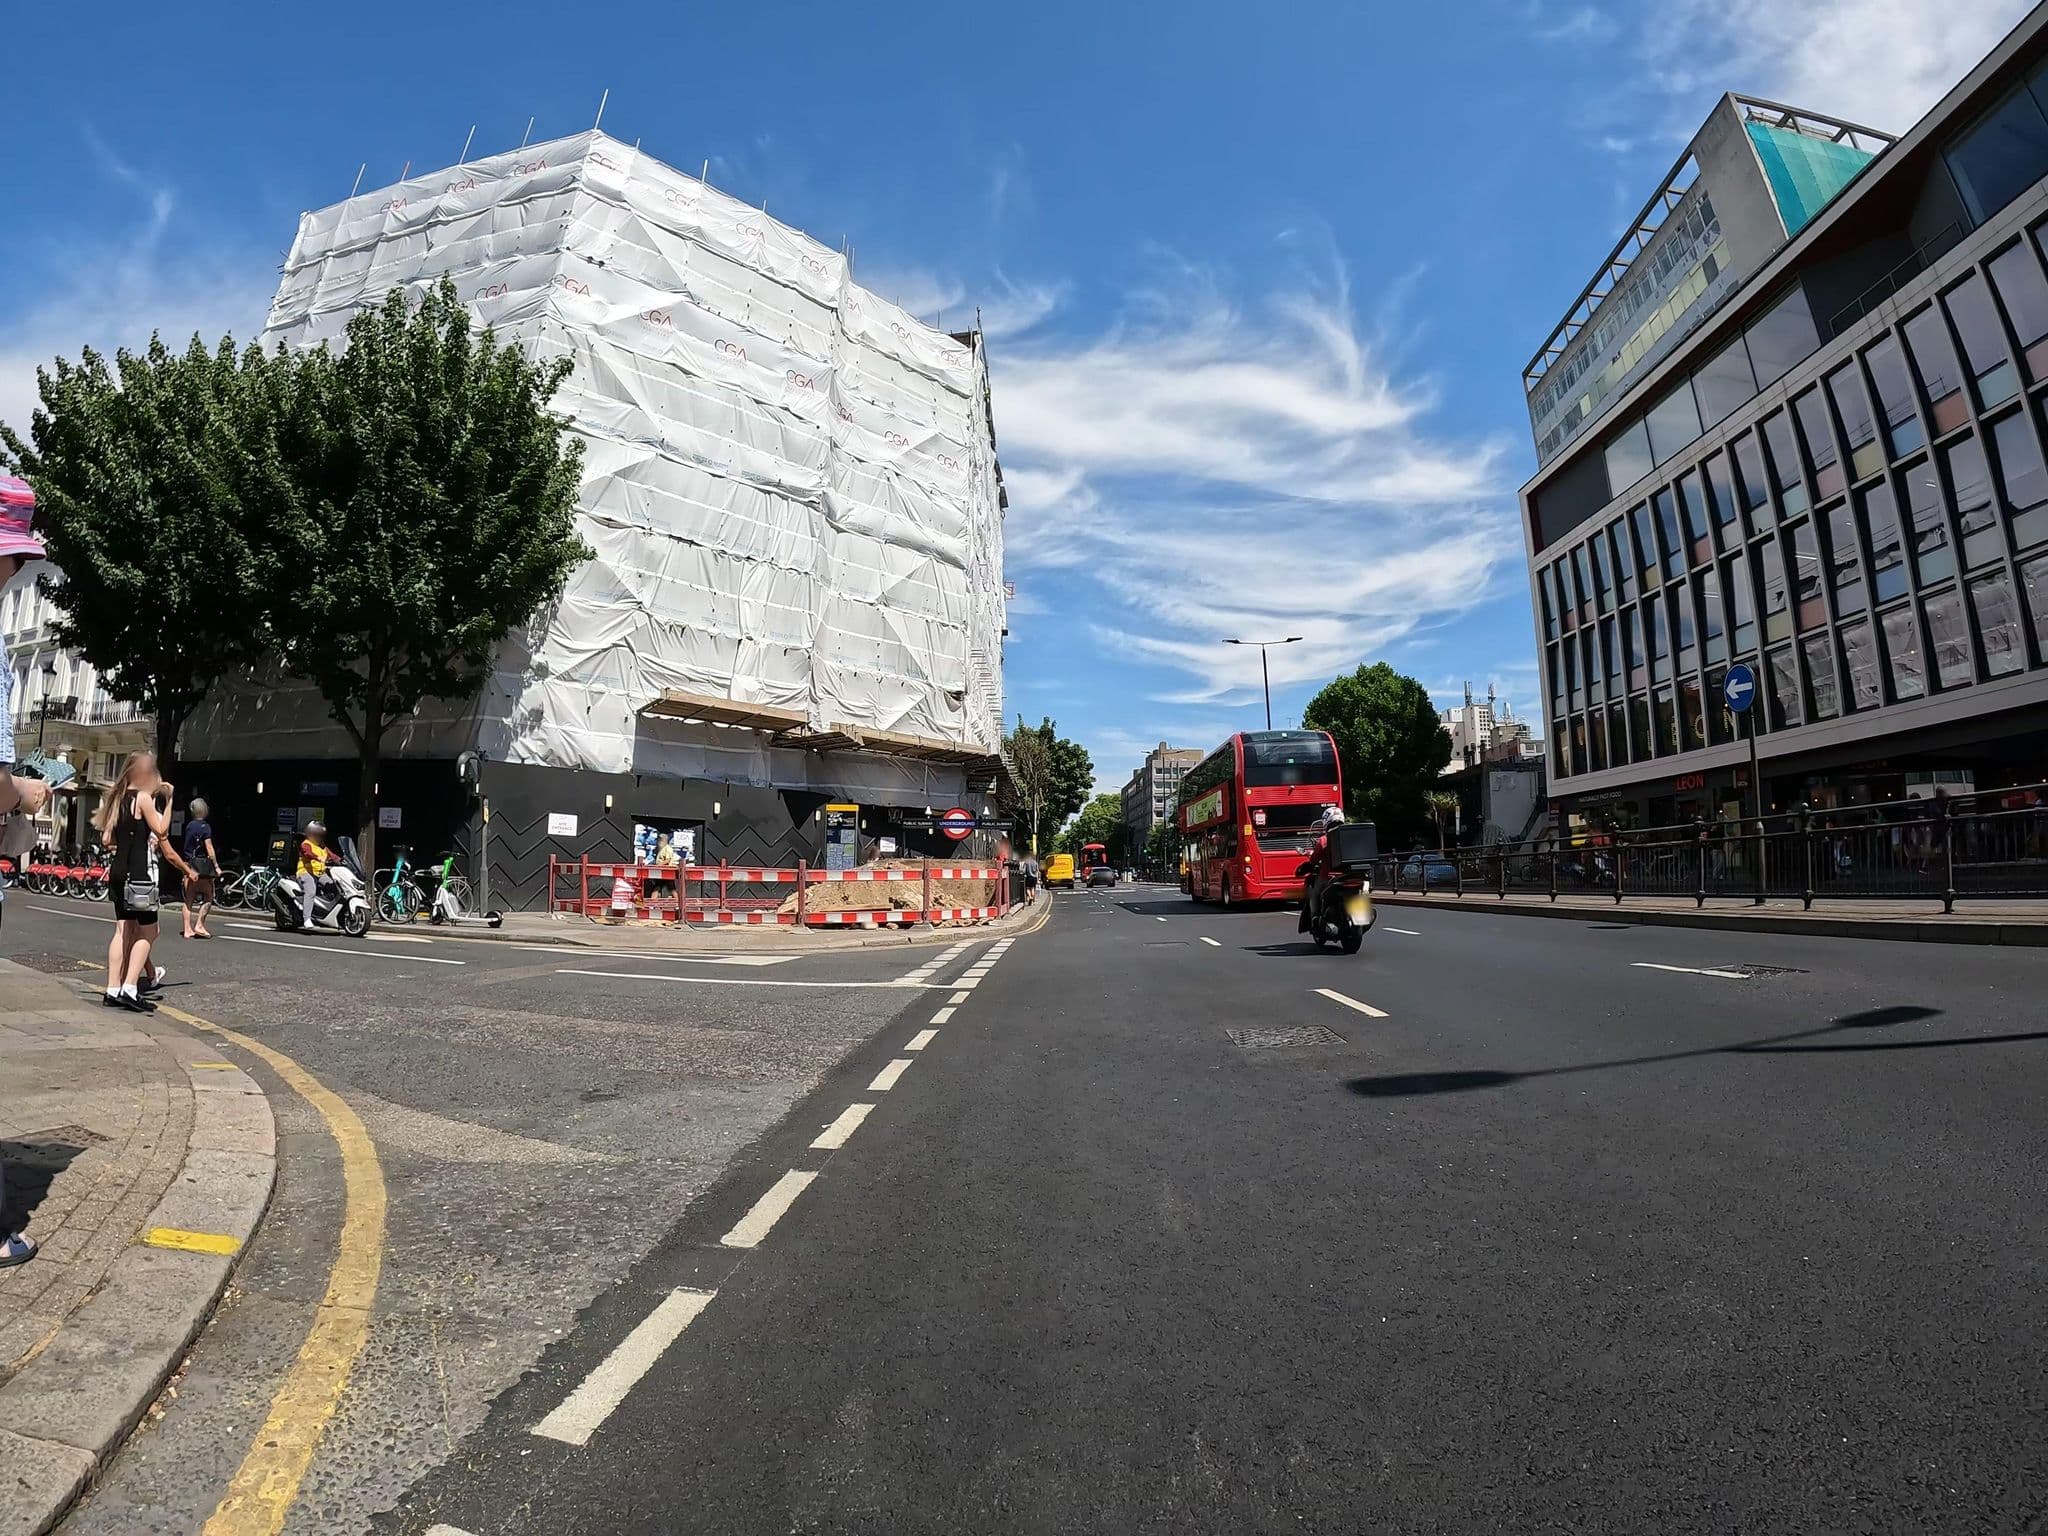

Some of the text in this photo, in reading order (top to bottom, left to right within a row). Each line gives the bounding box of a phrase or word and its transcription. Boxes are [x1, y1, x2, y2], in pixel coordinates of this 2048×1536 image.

[514, 160, 548, 176] CGA
[444, 178, 475, 192] CGA
[735, 222, 766, 244] CGA
[801, 255, 828, 276] CGA
[474, 283, 508, 300] CGA
[553, 273, 591, 297] CGA
[890, 322, 913, 344] CGA
[714, 339, 747, 361] CGA
[786, 369, 815, 392] CGA
[884, 430, 910, 447] CGA
[937, 453, 960, 470] CGA
[1676, 774, 1704, 791] LEON
